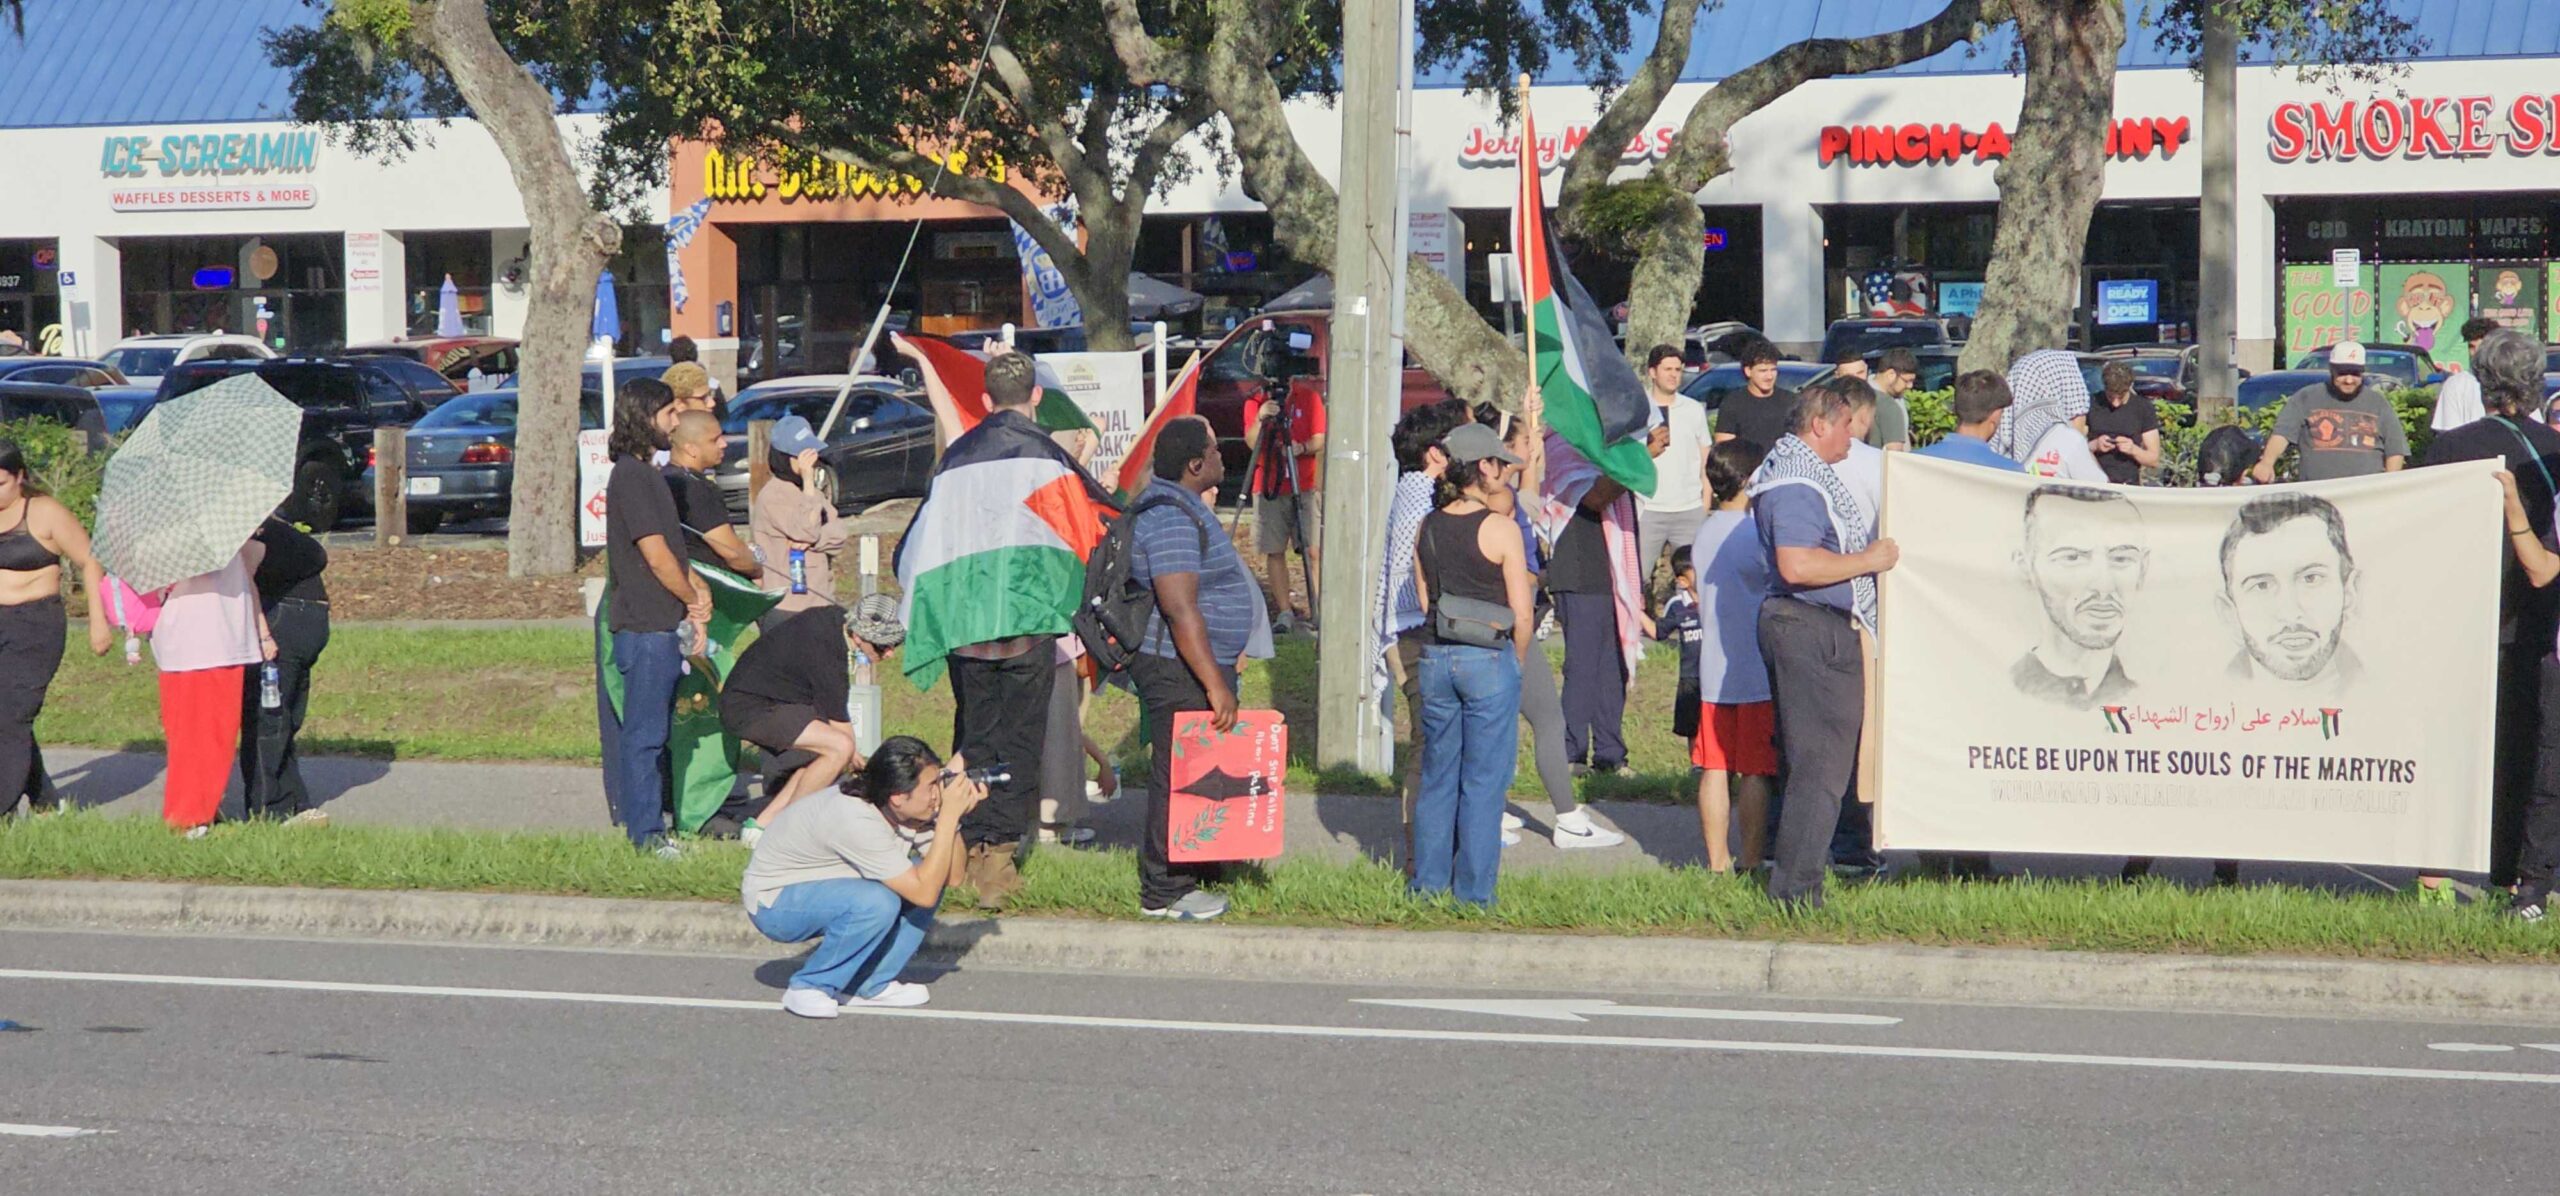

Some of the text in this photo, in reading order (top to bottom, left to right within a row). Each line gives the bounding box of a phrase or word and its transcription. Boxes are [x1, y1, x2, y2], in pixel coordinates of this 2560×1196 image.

[2270, 96, 2496, 159] SMOKE
[100, 132, 318, 174] ICE SCREAMIN
[113, 189, 310, 204] WAFFLES DESSERTS & MORE
[2385, 218, 2466, 237] KRATOM
[2480, 217, 2541, 235] VAPES
[2291, 271, 2322, 287] THE
[2106, 286, 2149, 300] READY
[2107, 304, 2149, 317] OPEN
[2241, 708, 2272, 731] على
[2278, 707, 2322, 731] سلام
[1969, 745, 2417, 783] PEACE BE UPON THE SOULS OF THE MARTYRS
